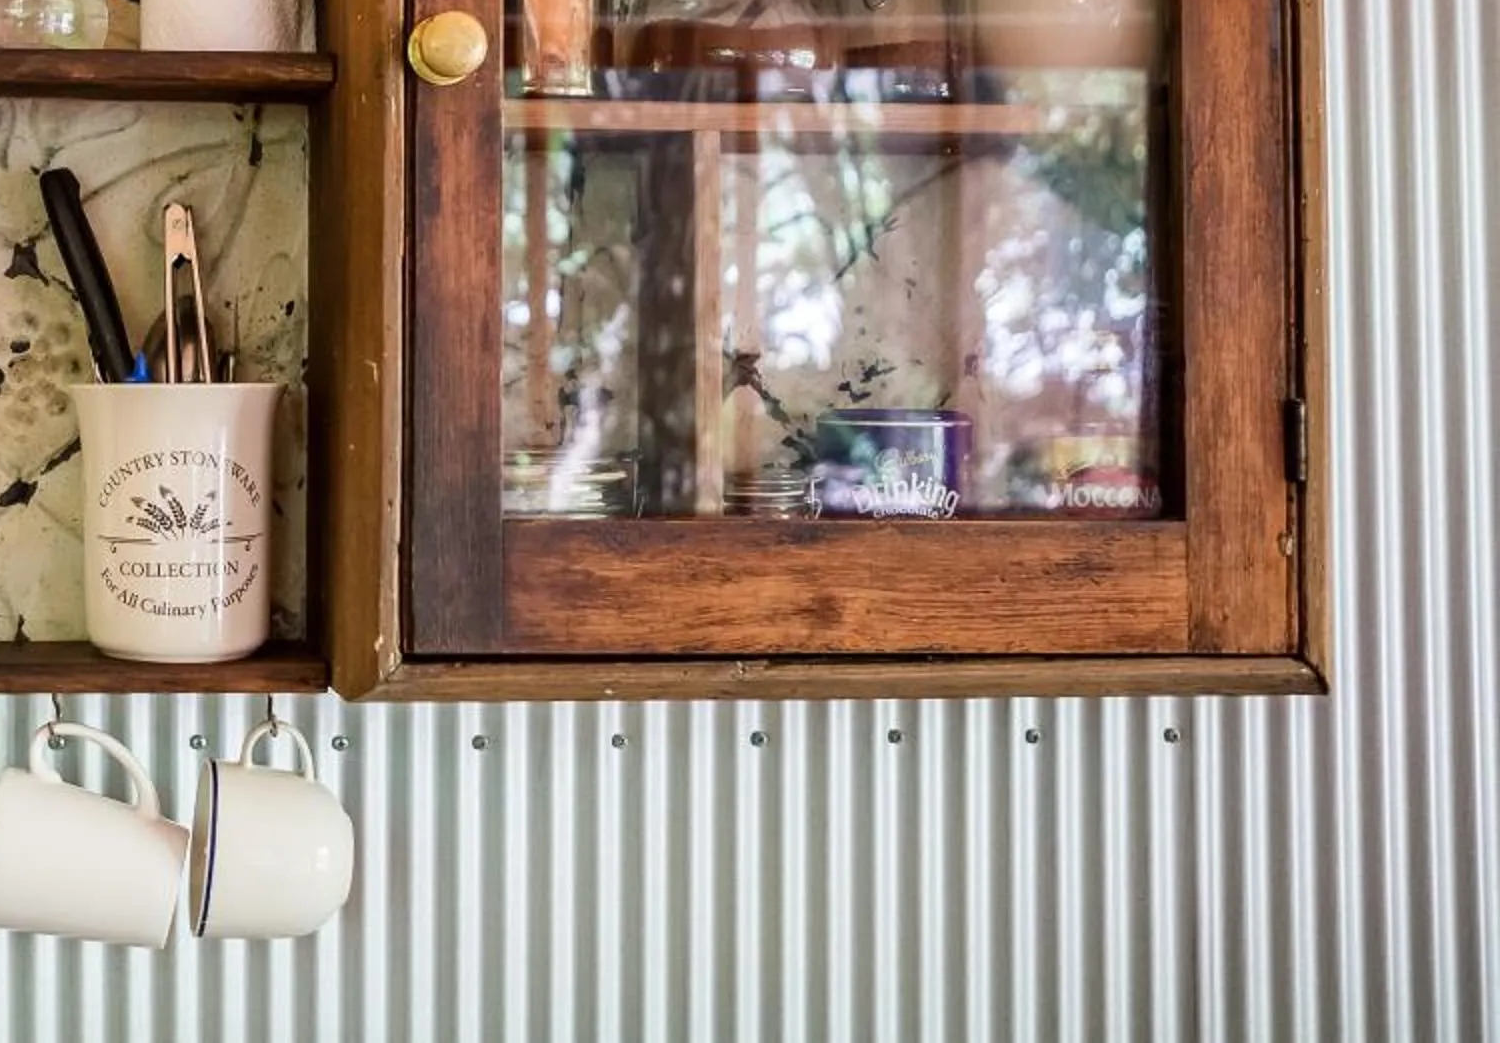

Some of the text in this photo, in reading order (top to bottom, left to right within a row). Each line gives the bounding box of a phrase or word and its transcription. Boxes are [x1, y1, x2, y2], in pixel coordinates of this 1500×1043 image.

[99, 450, 261, 508] COUNTRY STONWARE
[851, 472, 960, 518] Drinking
[100, 566, 119, 593] For
[117, 590, 139, 609] All
[140, 598, 208, 619] Culinary
[119, 560, 239, 578] COLLECTION
